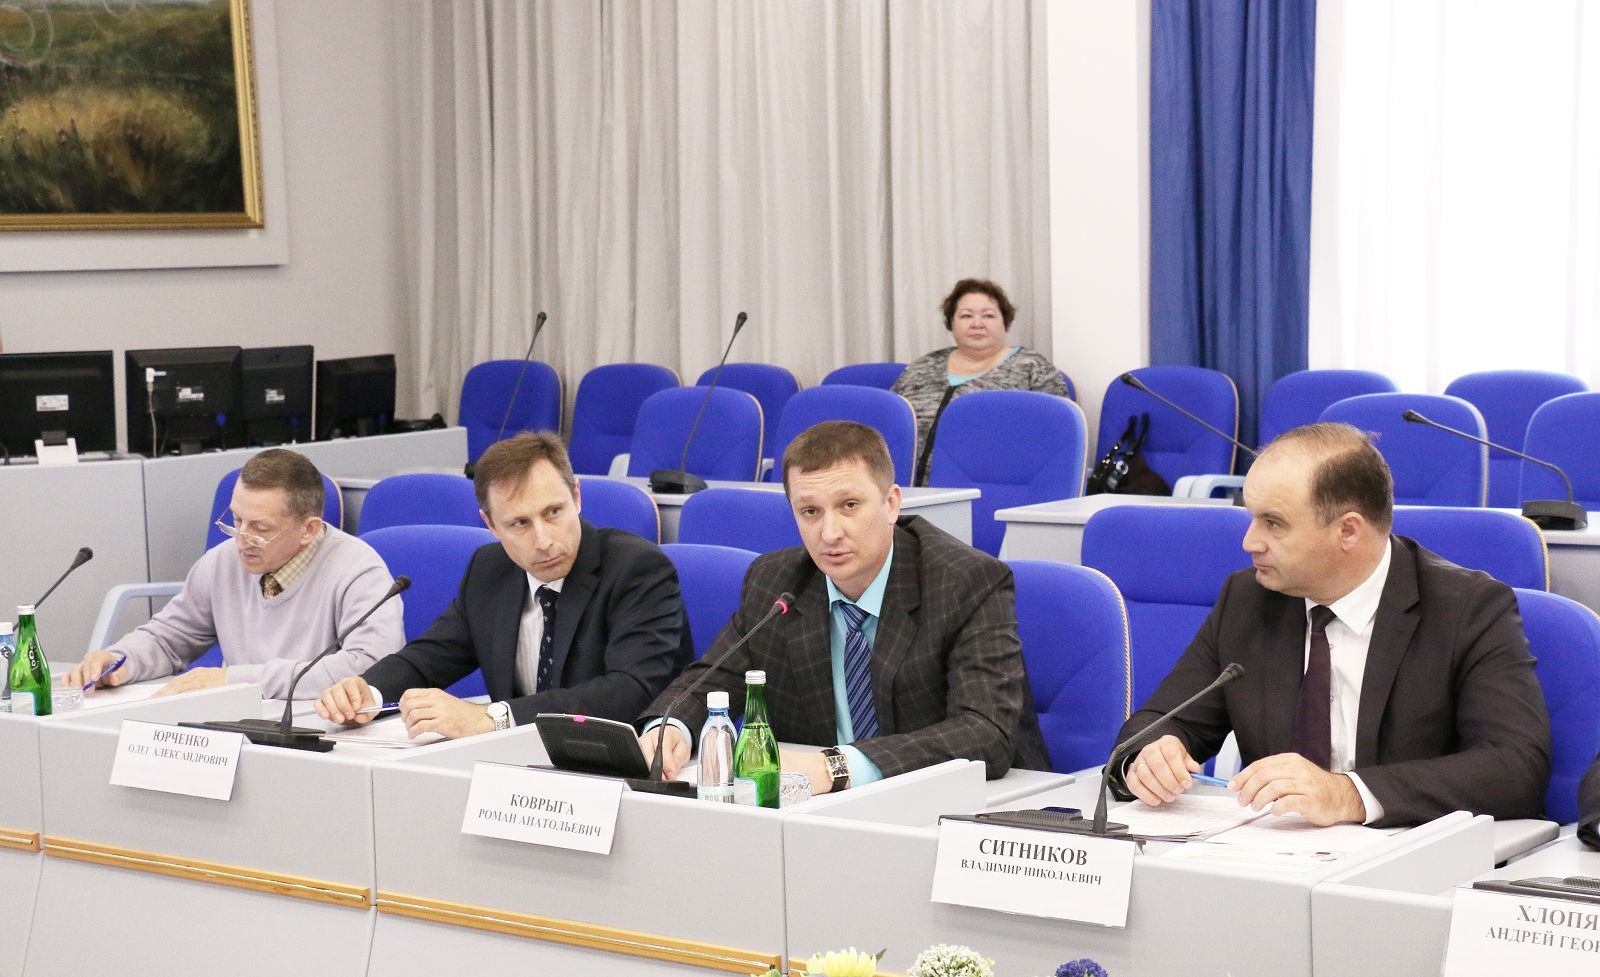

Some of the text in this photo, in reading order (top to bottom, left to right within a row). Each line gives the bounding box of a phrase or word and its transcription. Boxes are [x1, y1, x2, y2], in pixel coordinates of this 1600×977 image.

[153, 729, 210, 748] ЮРЧЕНКО
[128, 743, 229, 767] ОЛЕГ АЛЕКСАНДРОВИЧ
[510, 793, 575, 816] КОВРЫГА
[478, 808, 602, 837] РОМАН АНАТОЛЬЕВИЧ
[979, 838, 1088, 866] СИТНИКОВ
[961, 858, 1102, 885] ВЛАДИМИР НИКОЛАЕВИЧ
[1517, 904, 1600, 931] ХЛОПЯ
[1485, 926, 1555, 947] АНДРЕЙ
